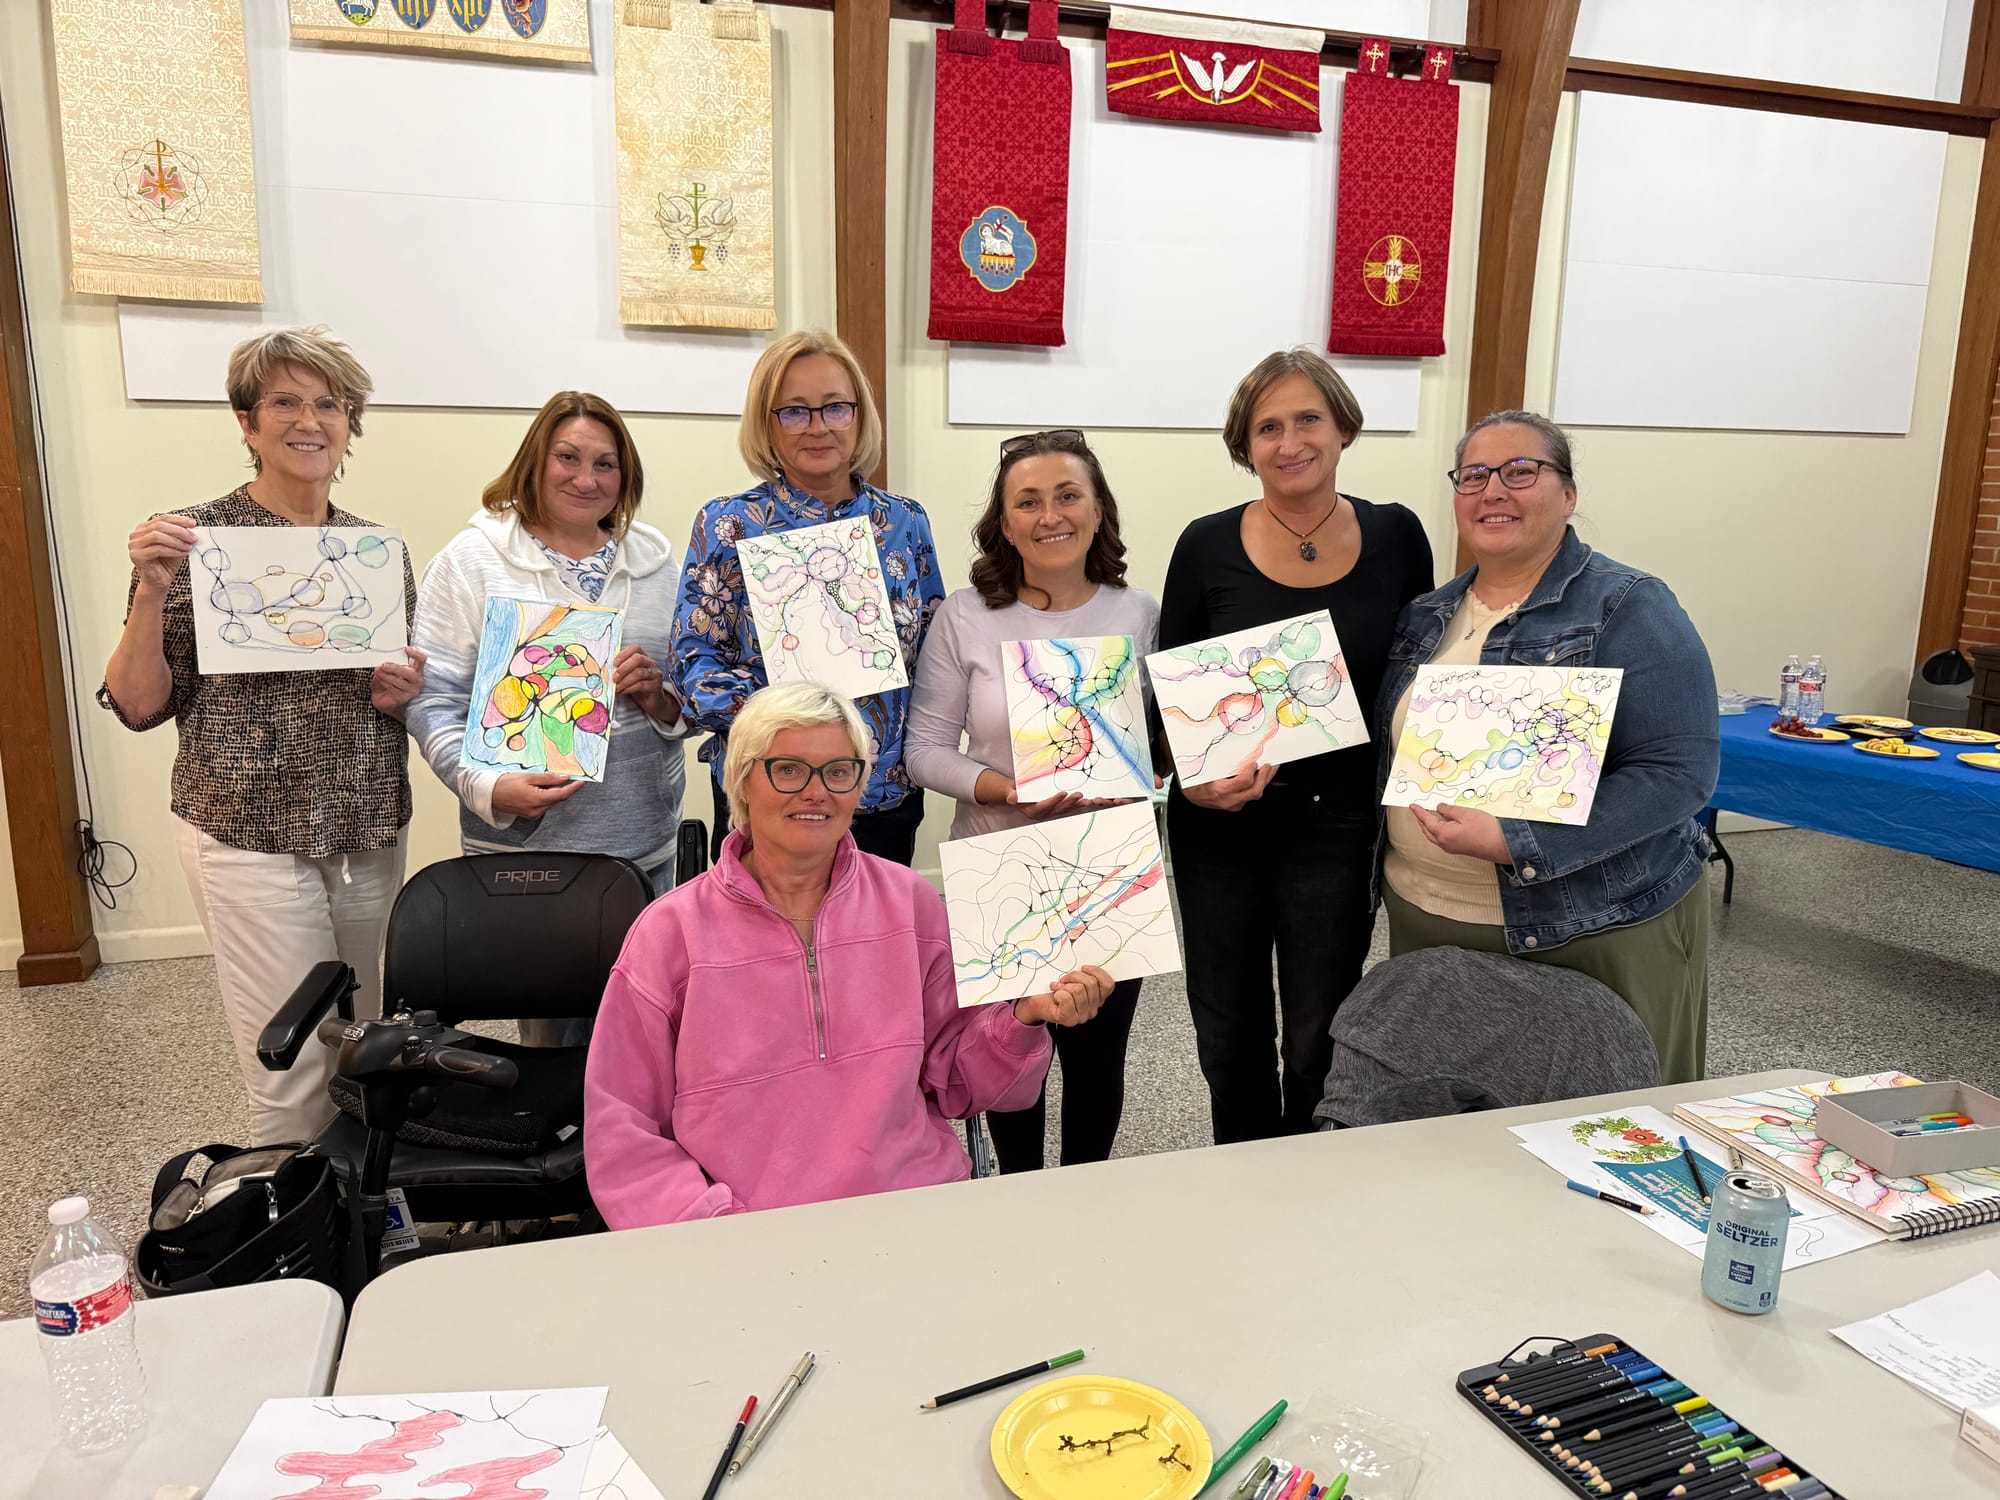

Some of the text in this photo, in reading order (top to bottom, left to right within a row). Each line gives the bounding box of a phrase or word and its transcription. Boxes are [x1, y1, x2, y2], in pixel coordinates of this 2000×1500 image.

[1385, 264, 1402, 277] IHC
[495, 870, 561, 883] PRIDE
[1715, 1222, 1778, 1248] SELTZER
[1725, 1220, 1770, 1237] ORIGINAL
